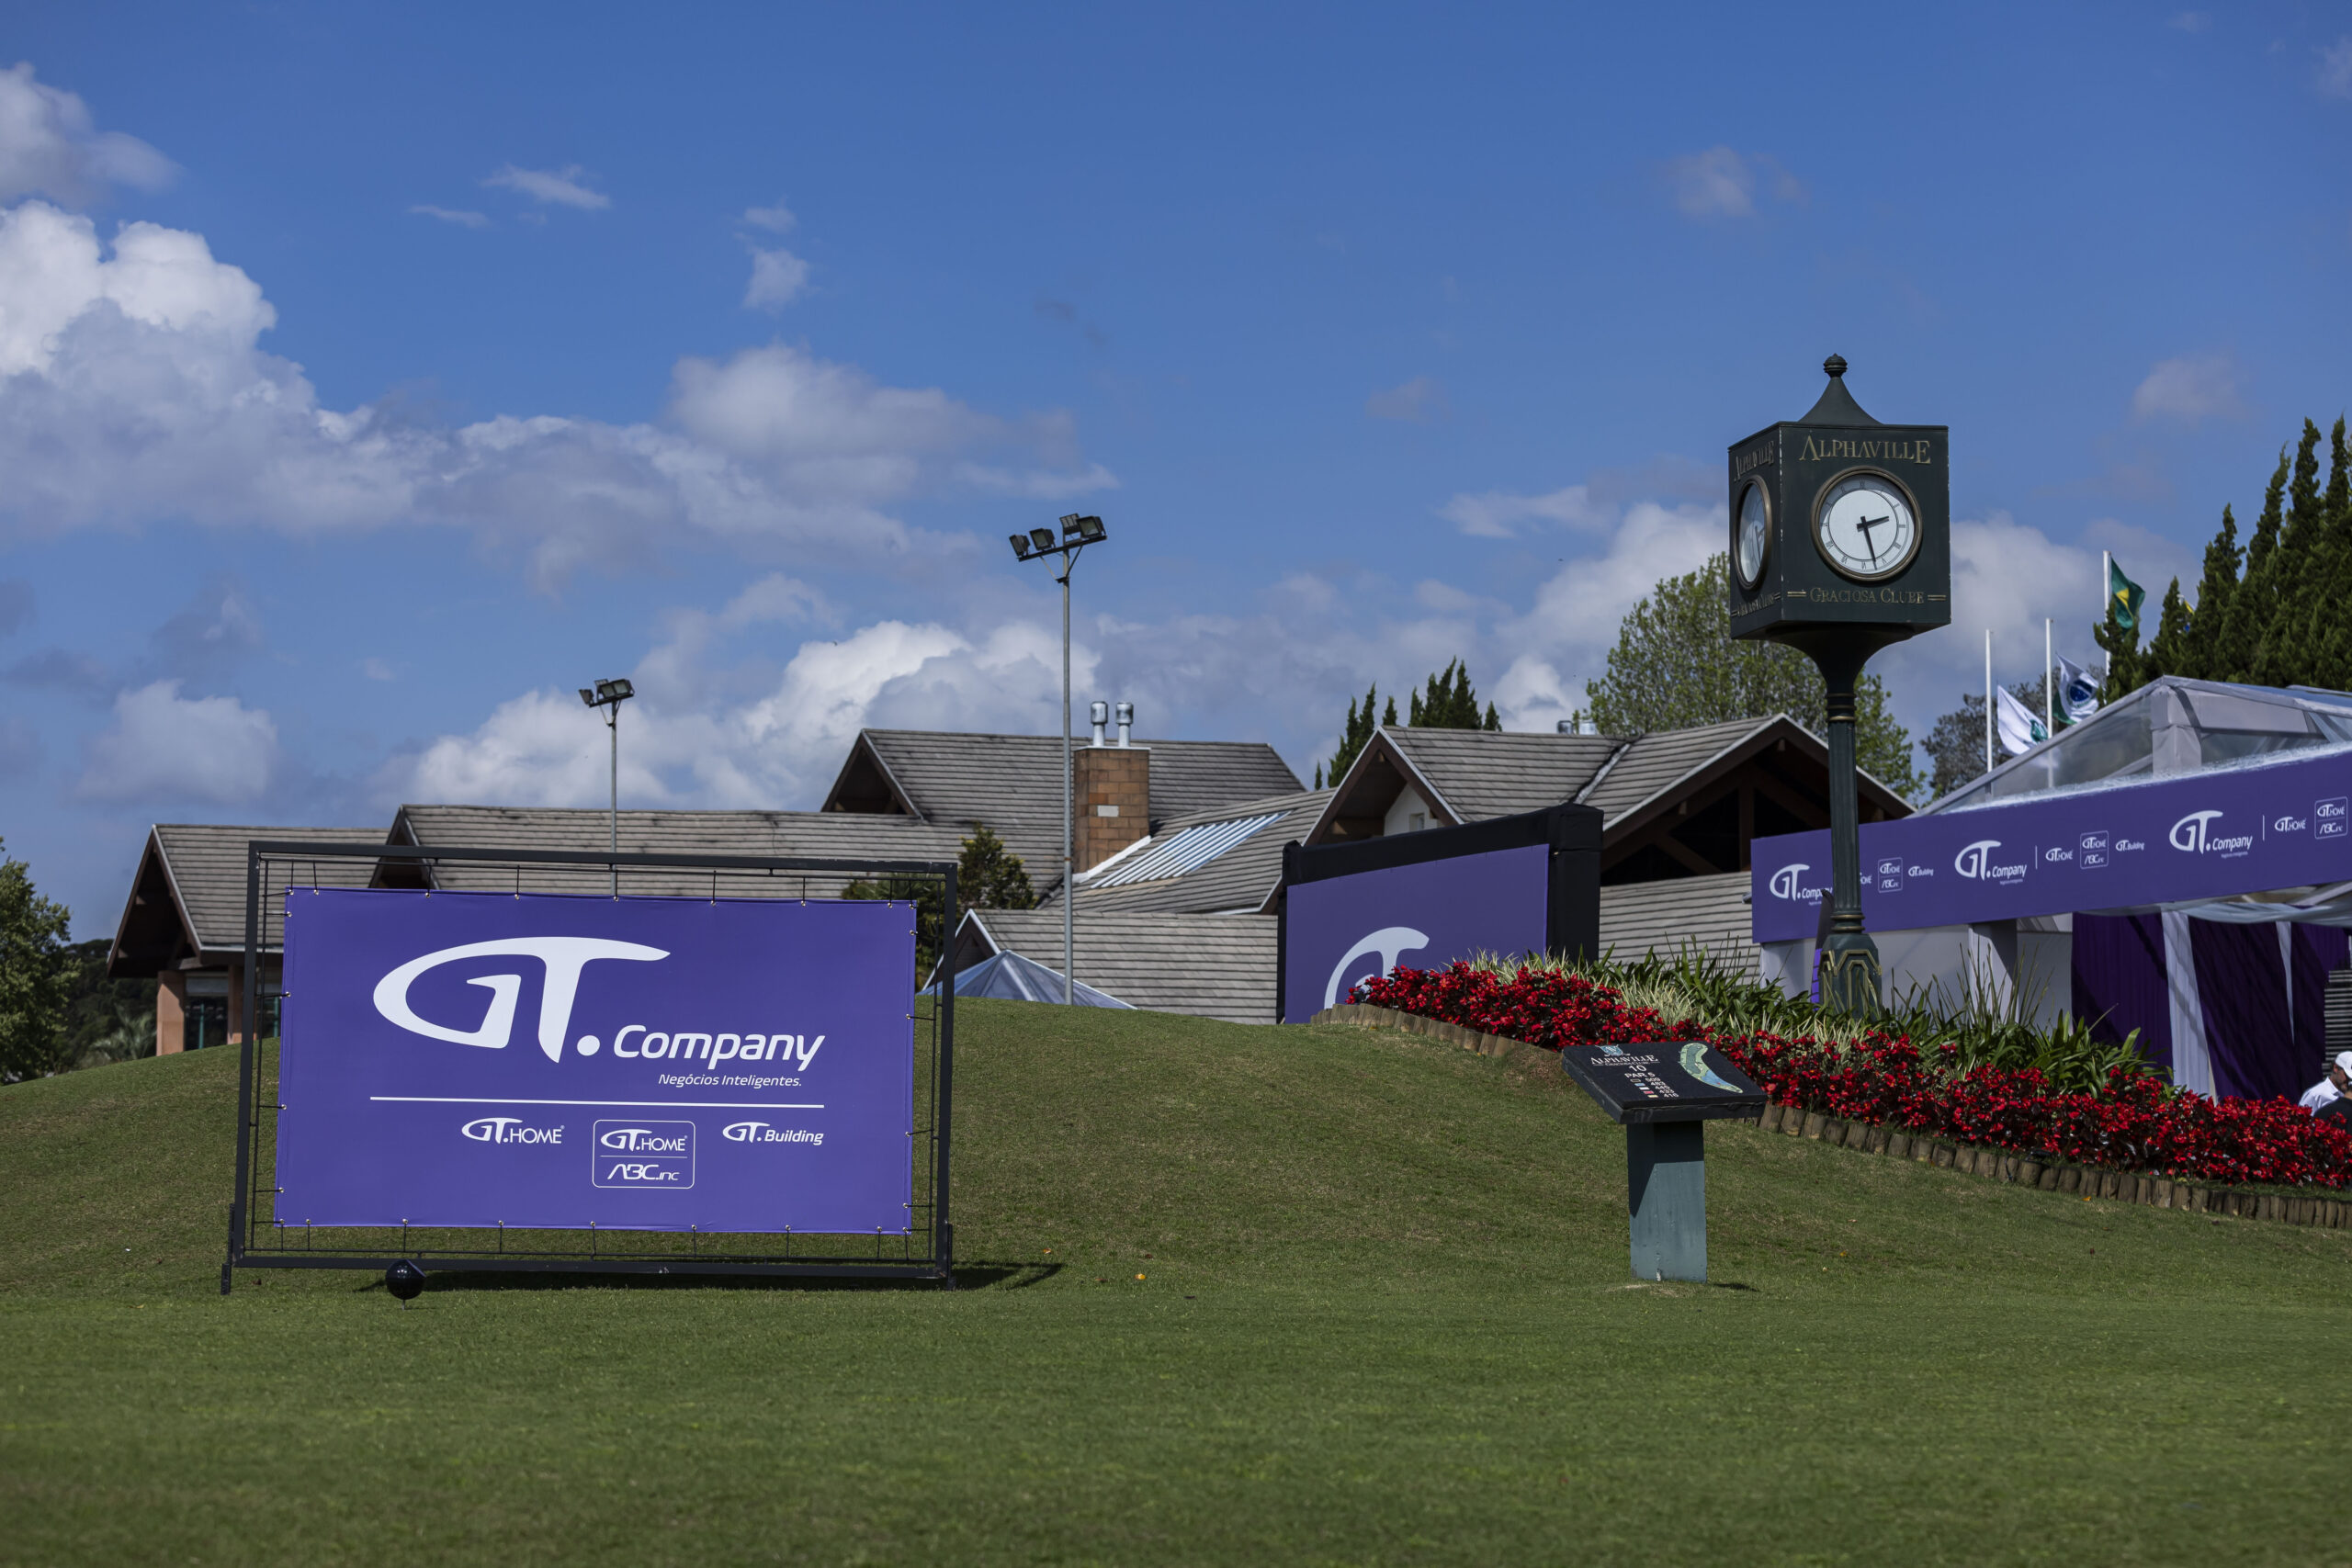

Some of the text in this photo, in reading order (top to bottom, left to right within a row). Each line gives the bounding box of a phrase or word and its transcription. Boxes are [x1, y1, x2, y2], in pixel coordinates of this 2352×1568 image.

[1799, 434, 1931, 464] ALPHAVILLE
[1809, 587, 1877, 604] GRACIOSA
[2211, 835, 2254, 852] Company
[1992, 864, 2028, 879] Company
[613, 1024, 826, 1072] Company
[658, 1073, 802, 1089] Negócios Inteligentes.
